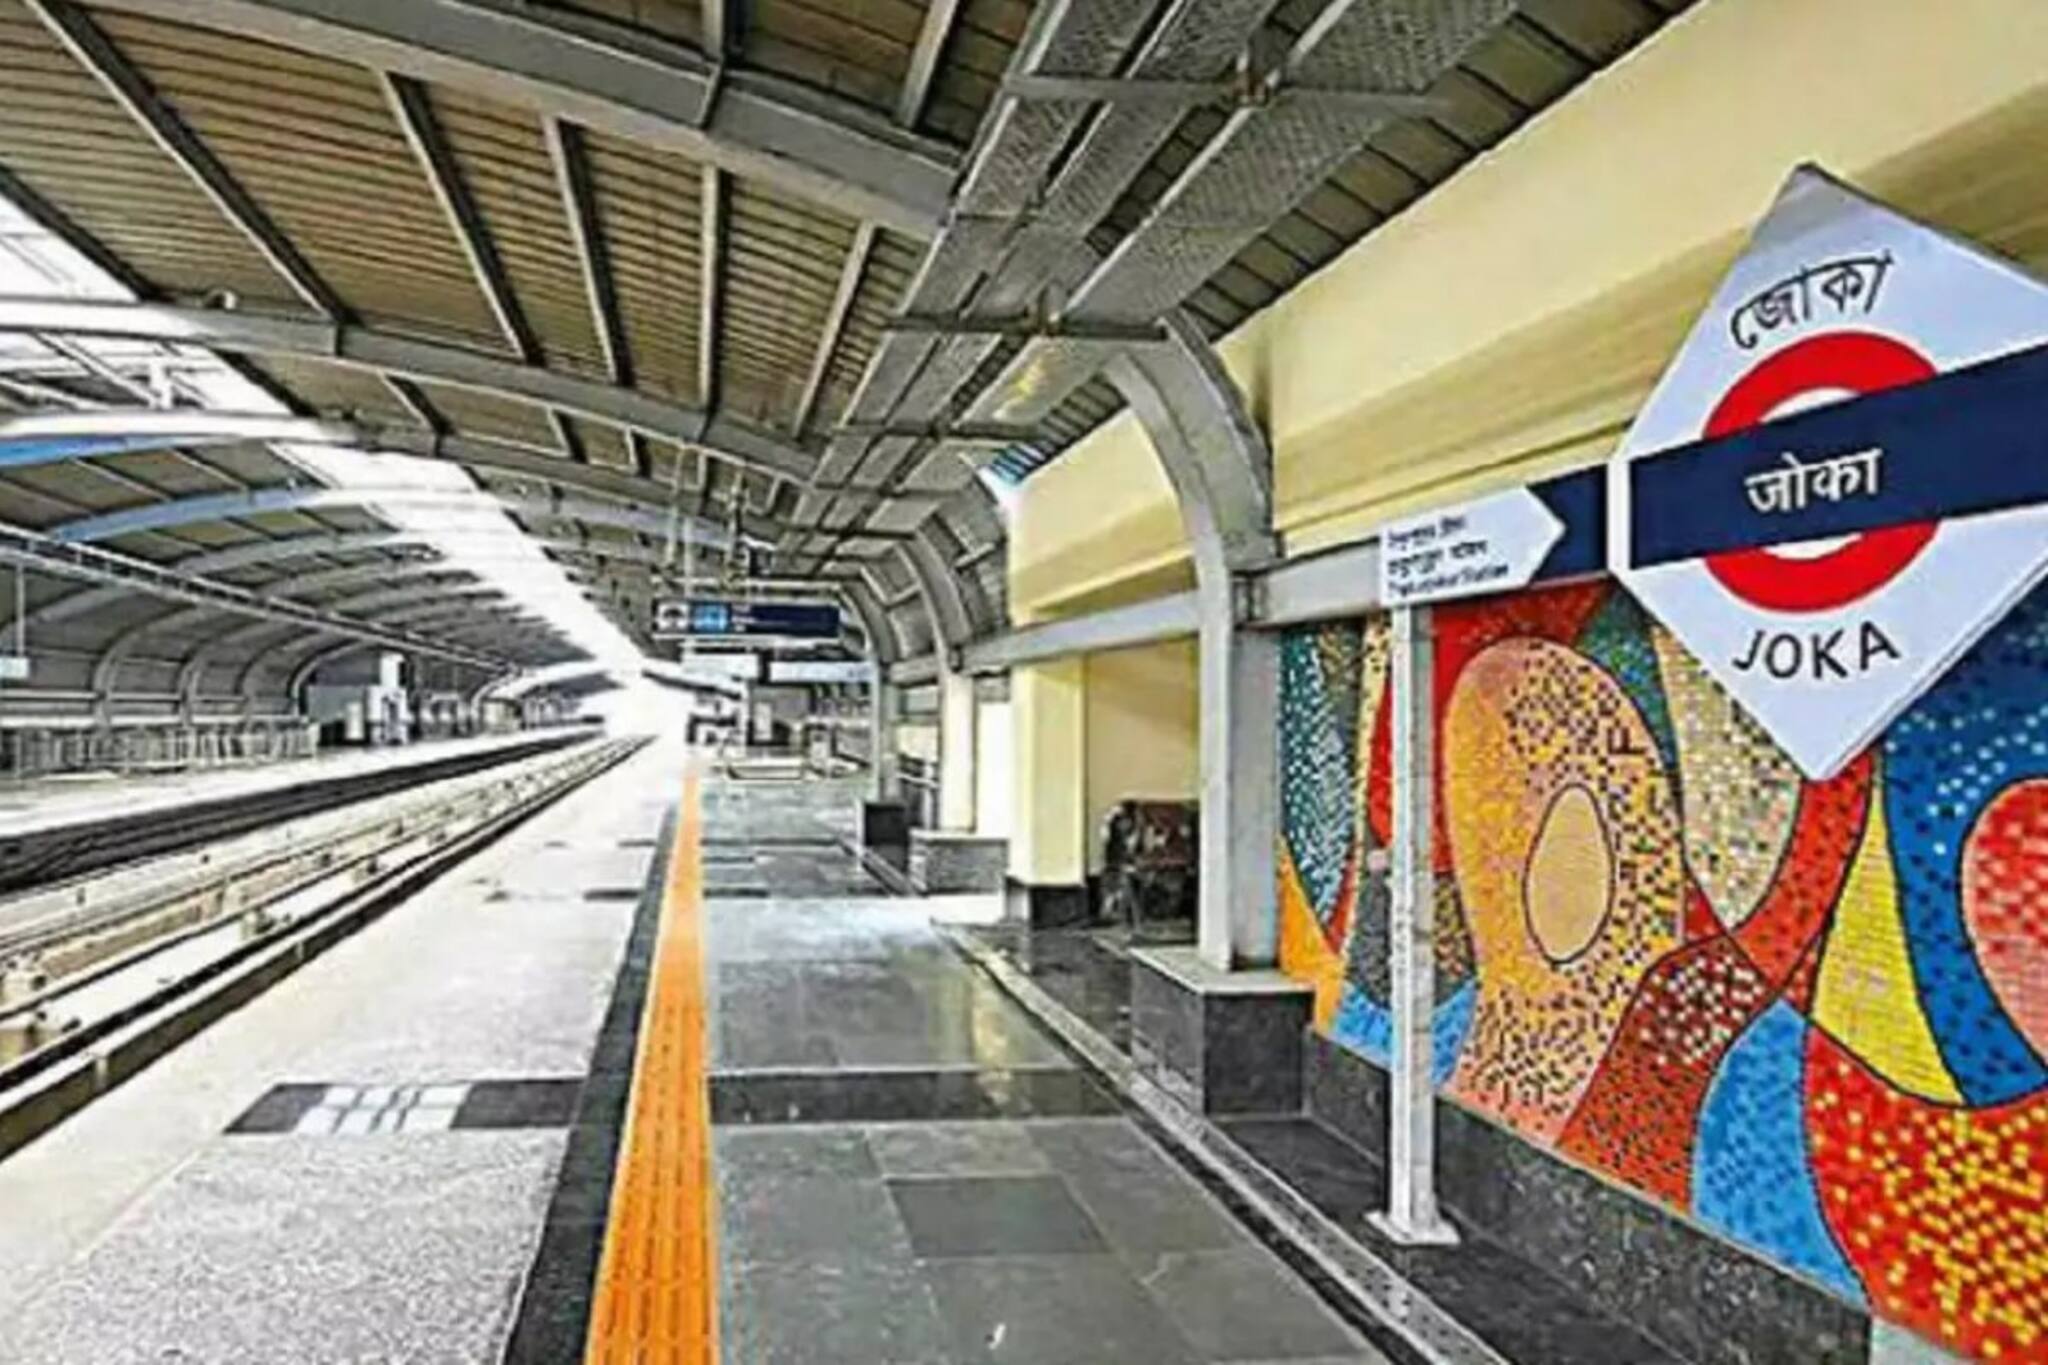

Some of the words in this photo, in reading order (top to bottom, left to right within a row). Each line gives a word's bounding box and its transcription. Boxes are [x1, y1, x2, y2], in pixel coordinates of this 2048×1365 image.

[1731, 249, 1894, 349] জোকা
[1744, 448, 1883, 514] जोका
[1732, 620, 1900, 679] JOKA
